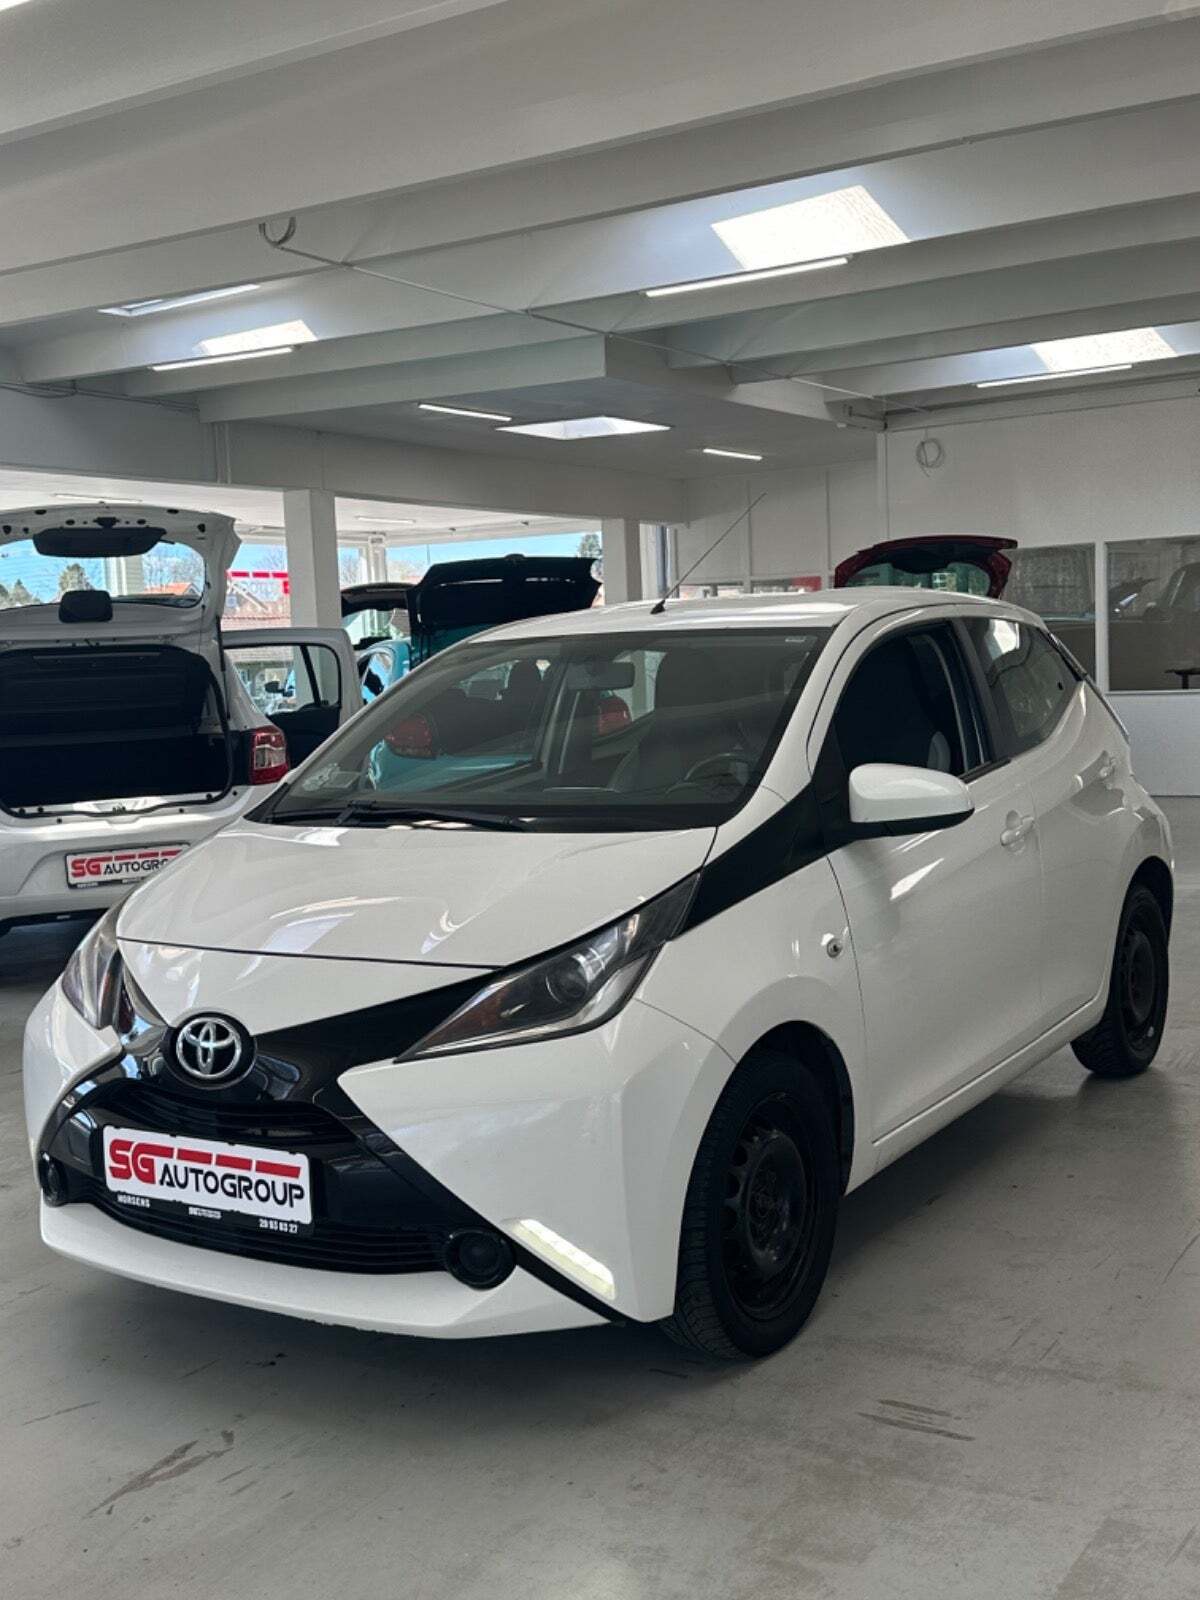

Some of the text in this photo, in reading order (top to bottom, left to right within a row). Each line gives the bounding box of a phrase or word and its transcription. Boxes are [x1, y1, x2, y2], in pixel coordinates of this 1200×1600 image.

[71, 857, 113, 878] SG
[109, 1138, 304, 1208] SG AUTOGROUP
